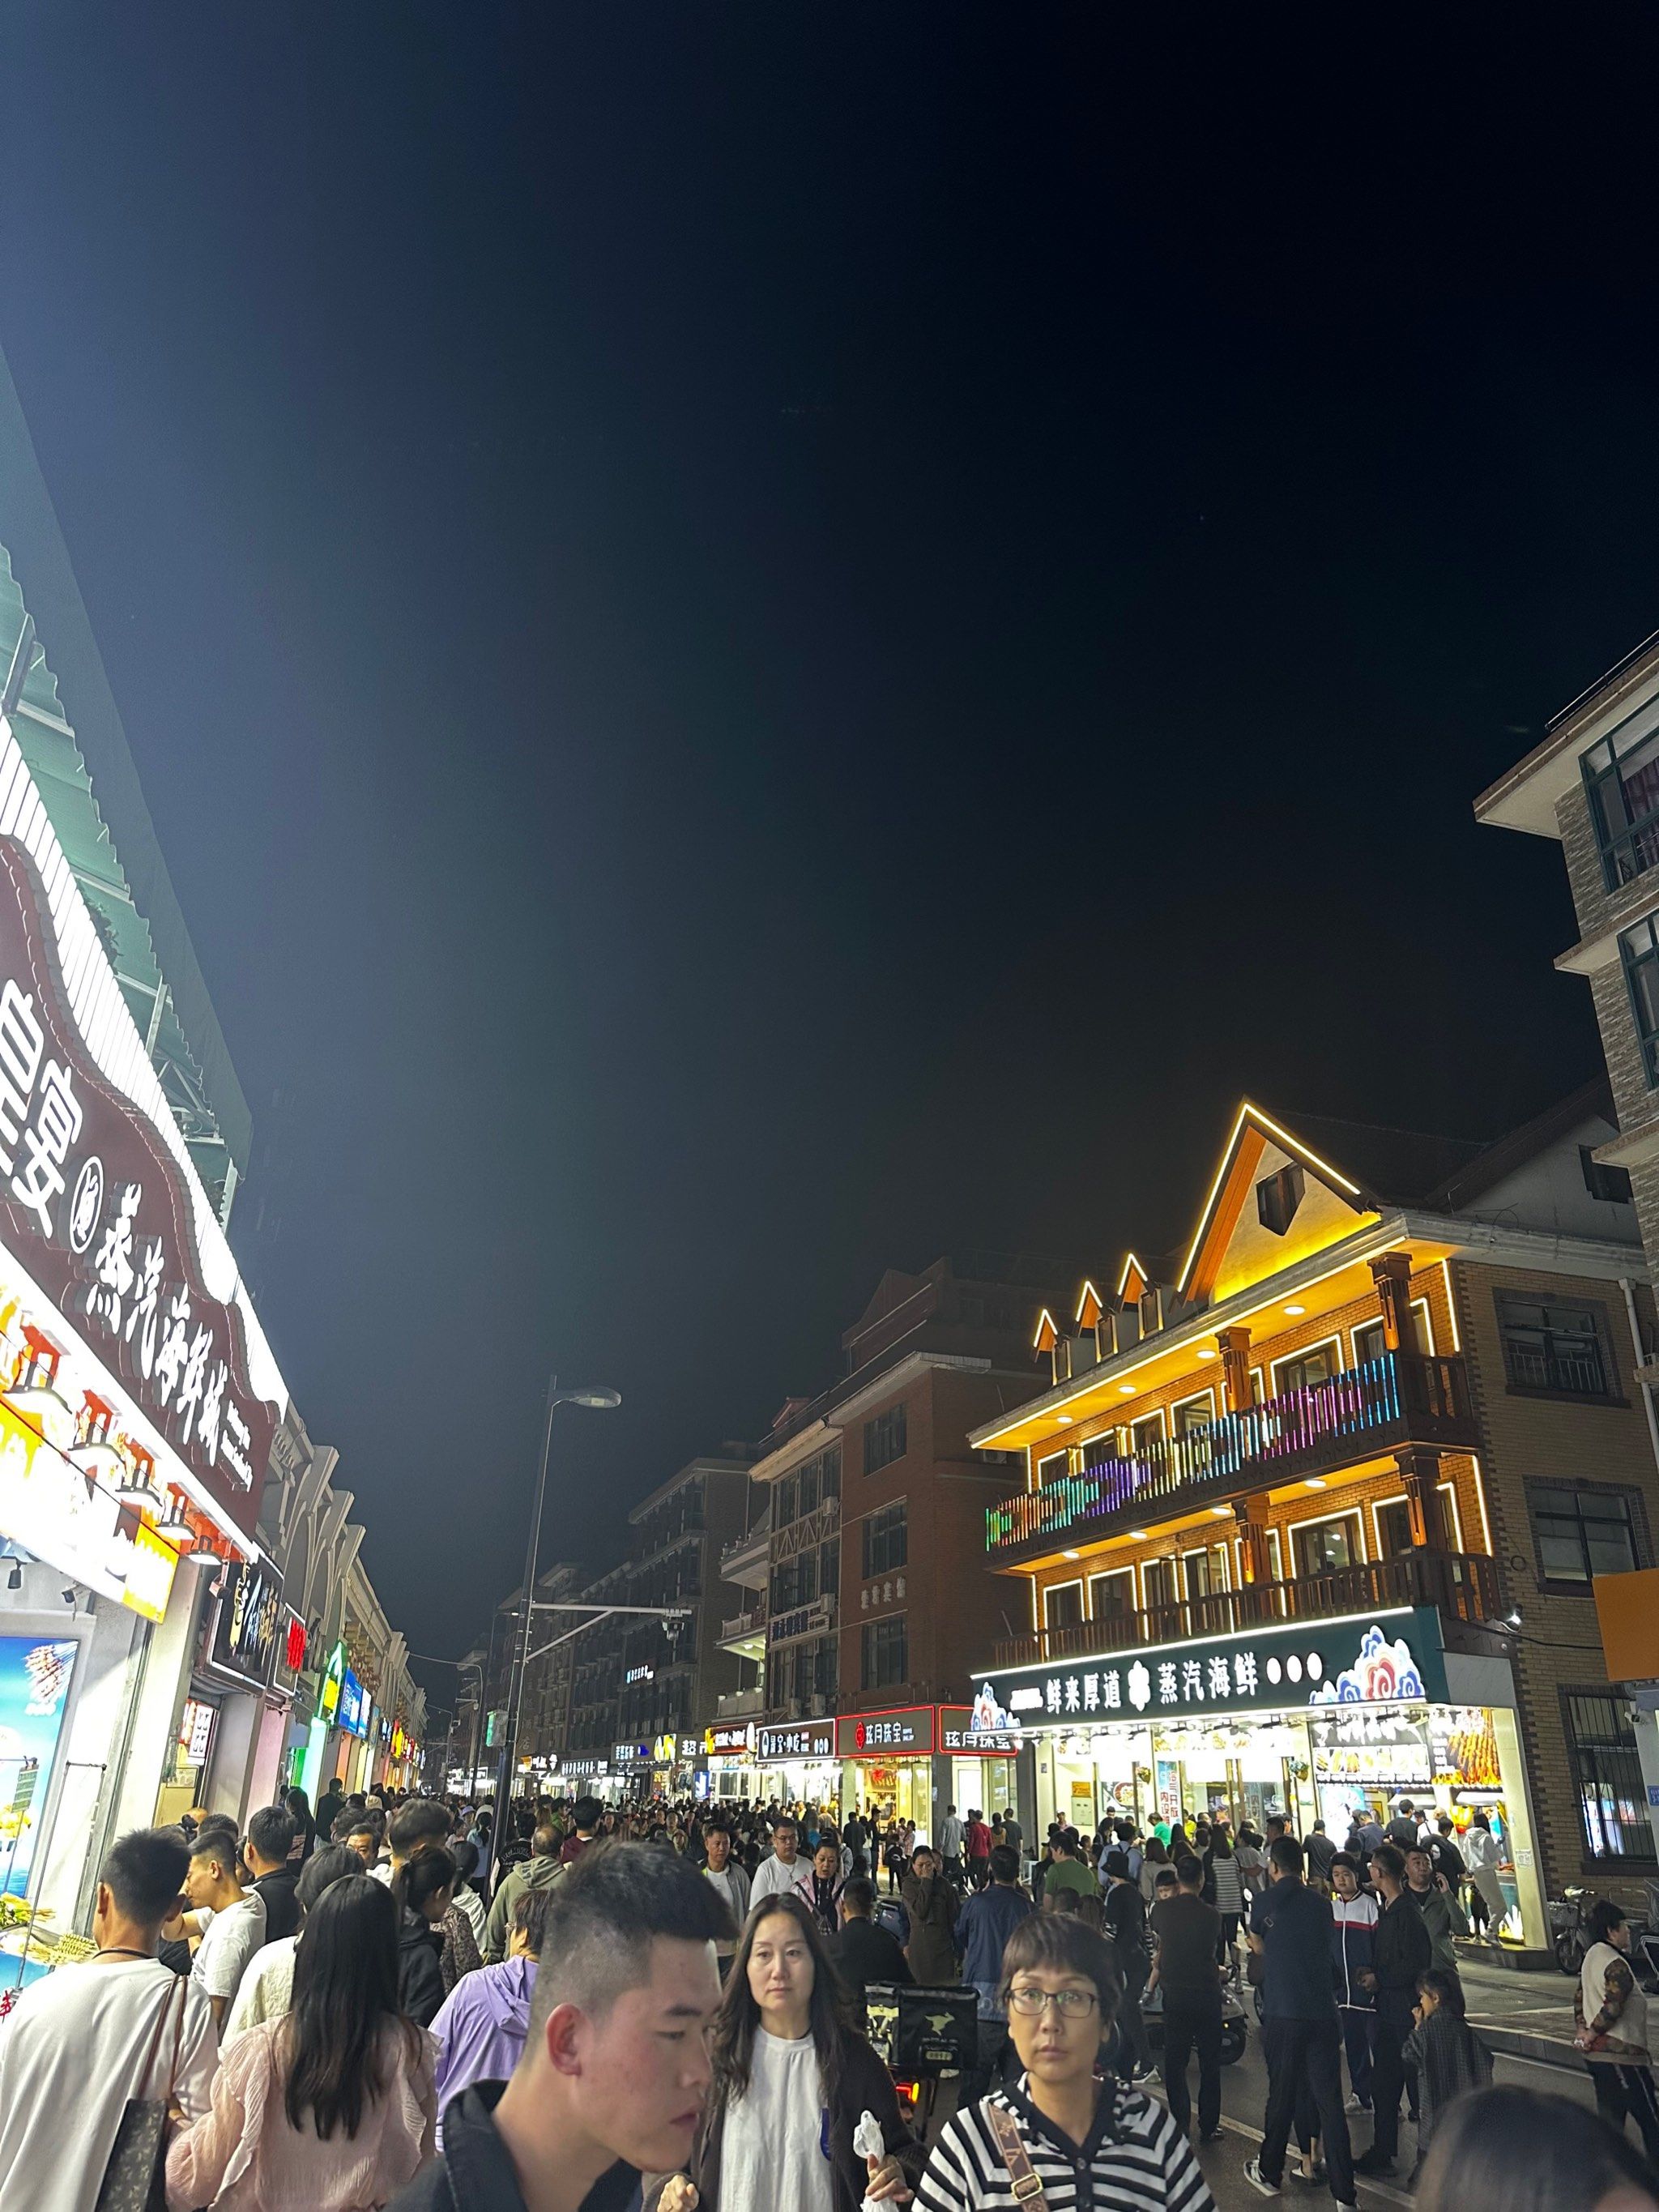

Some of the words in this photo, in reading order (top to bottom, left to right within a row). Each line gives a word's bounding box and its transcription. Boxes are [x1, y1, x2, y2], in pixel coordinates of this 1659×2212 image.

[1046, 1670, 1121, 1715] 鲜来厚道
[1158, 1651, 1259, 1704] 蒸汽海鲜
